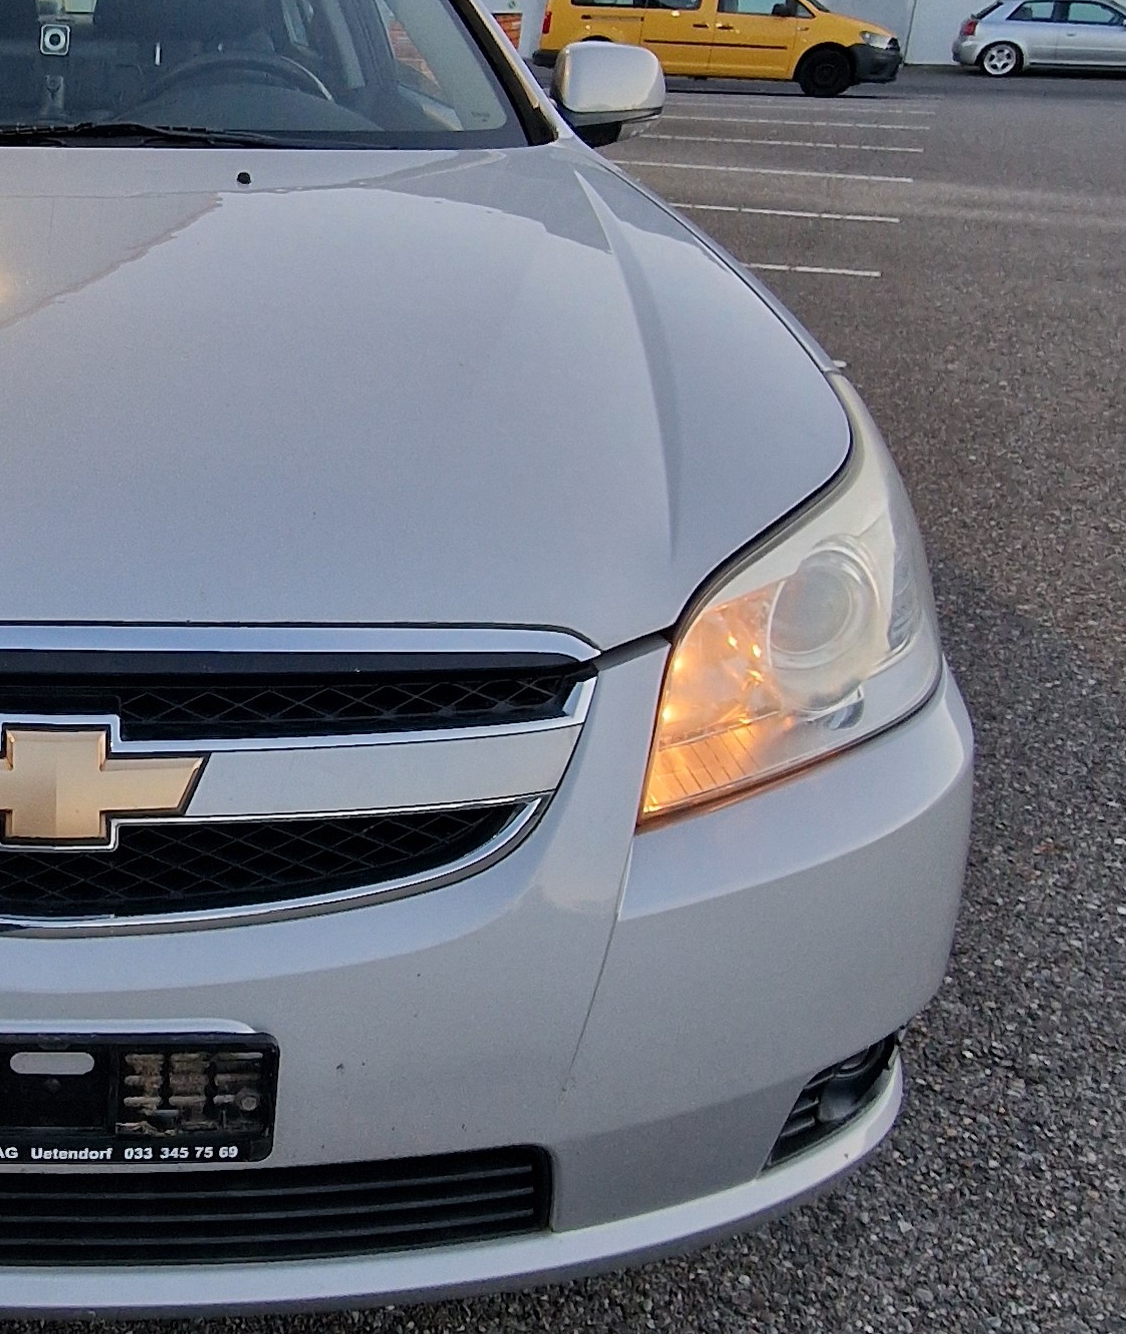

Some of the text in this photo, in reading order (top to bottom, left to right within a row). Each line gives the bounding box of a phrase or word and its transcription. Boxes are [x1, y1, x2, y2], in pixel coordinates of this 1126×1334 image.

[30, 1147, 113, 1160] Uetendorf
[124, 1147, 153, 1160] 033
[159, 1146, 190, 1159] 345
[194, 1146, 214, 1159] 75
[218, 1145, 239, 1159] 69
